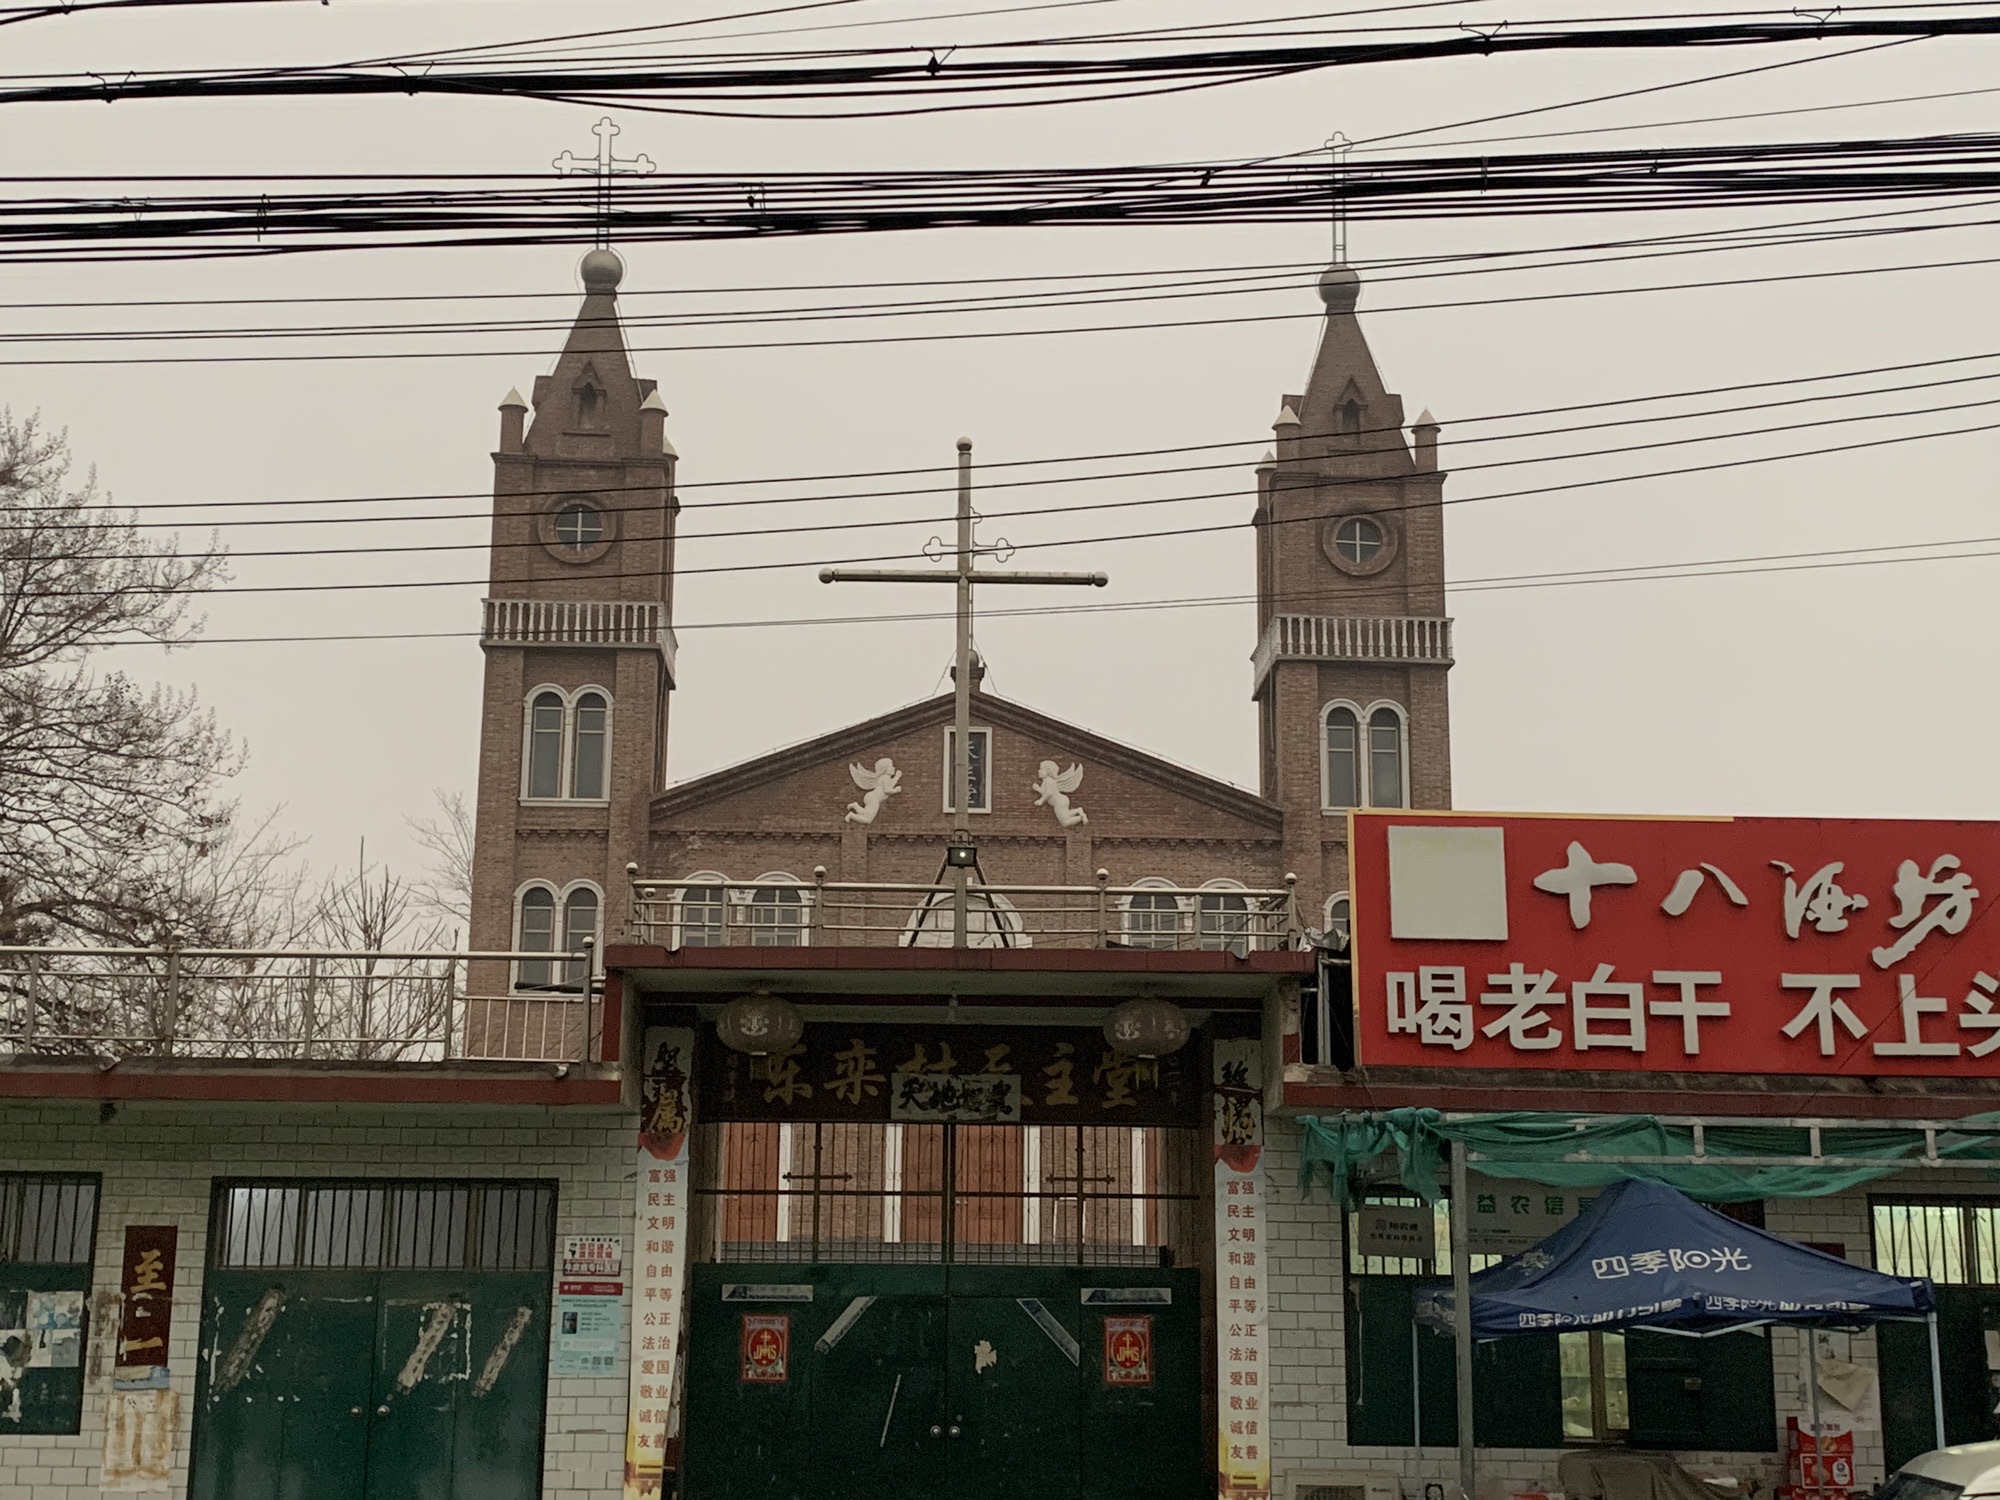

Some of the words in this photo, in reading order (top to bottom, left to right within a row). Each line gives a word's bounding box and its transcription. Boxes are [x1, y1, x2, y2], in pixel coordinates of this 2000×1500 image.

[1533, 840, 1980, 969] 十八酒坊
[1386, 963, 1731, 1054] 喝老白干
[648, 1169, 676, 1183] 富强
[1226, 1181, 1254, 1195] 富强
[647, 1192, 676, 1206] 民主
[1227, 1204, 1255, 1218] 民主
[646, 1216, 675, 1230] 文明
[1228, 1227, 1255, 1242] 文明
[645, 1240, 674, 1254] 和谐
[1228, 1251, 1256, 1266] 和谐
[1592, 1246, 1752, 1280] 四季阳光
[646, 1264, 672, 1278] 自由
[1229, 1275, 1256, 1289] 自由
[644, 1288, 672, 1302] 平等
[1228, 1299, 1257, 1314] 平等
[643, 1312, 671, 1326] 公正
[1229, 1323, 1258, 1337] 公正
[642, 1336, 671, 1350] 法治
[1229, 1347, 1258, 1361] 法治
[641, 1360, 670, 1375] 爱国
[1230, 1371, 1258, 1386] 爱国
[640, 1384, 668, 1399] 敬业
[1230, 1395, 1258, 1410] 敬业
[639, 1409, 668, 1424] 诚信
[1229, 1420, 1258, 1435] 诚信
[637, 1433, 665, 1448] 友善
[1230, 1444, 1258, 1459] 友善
